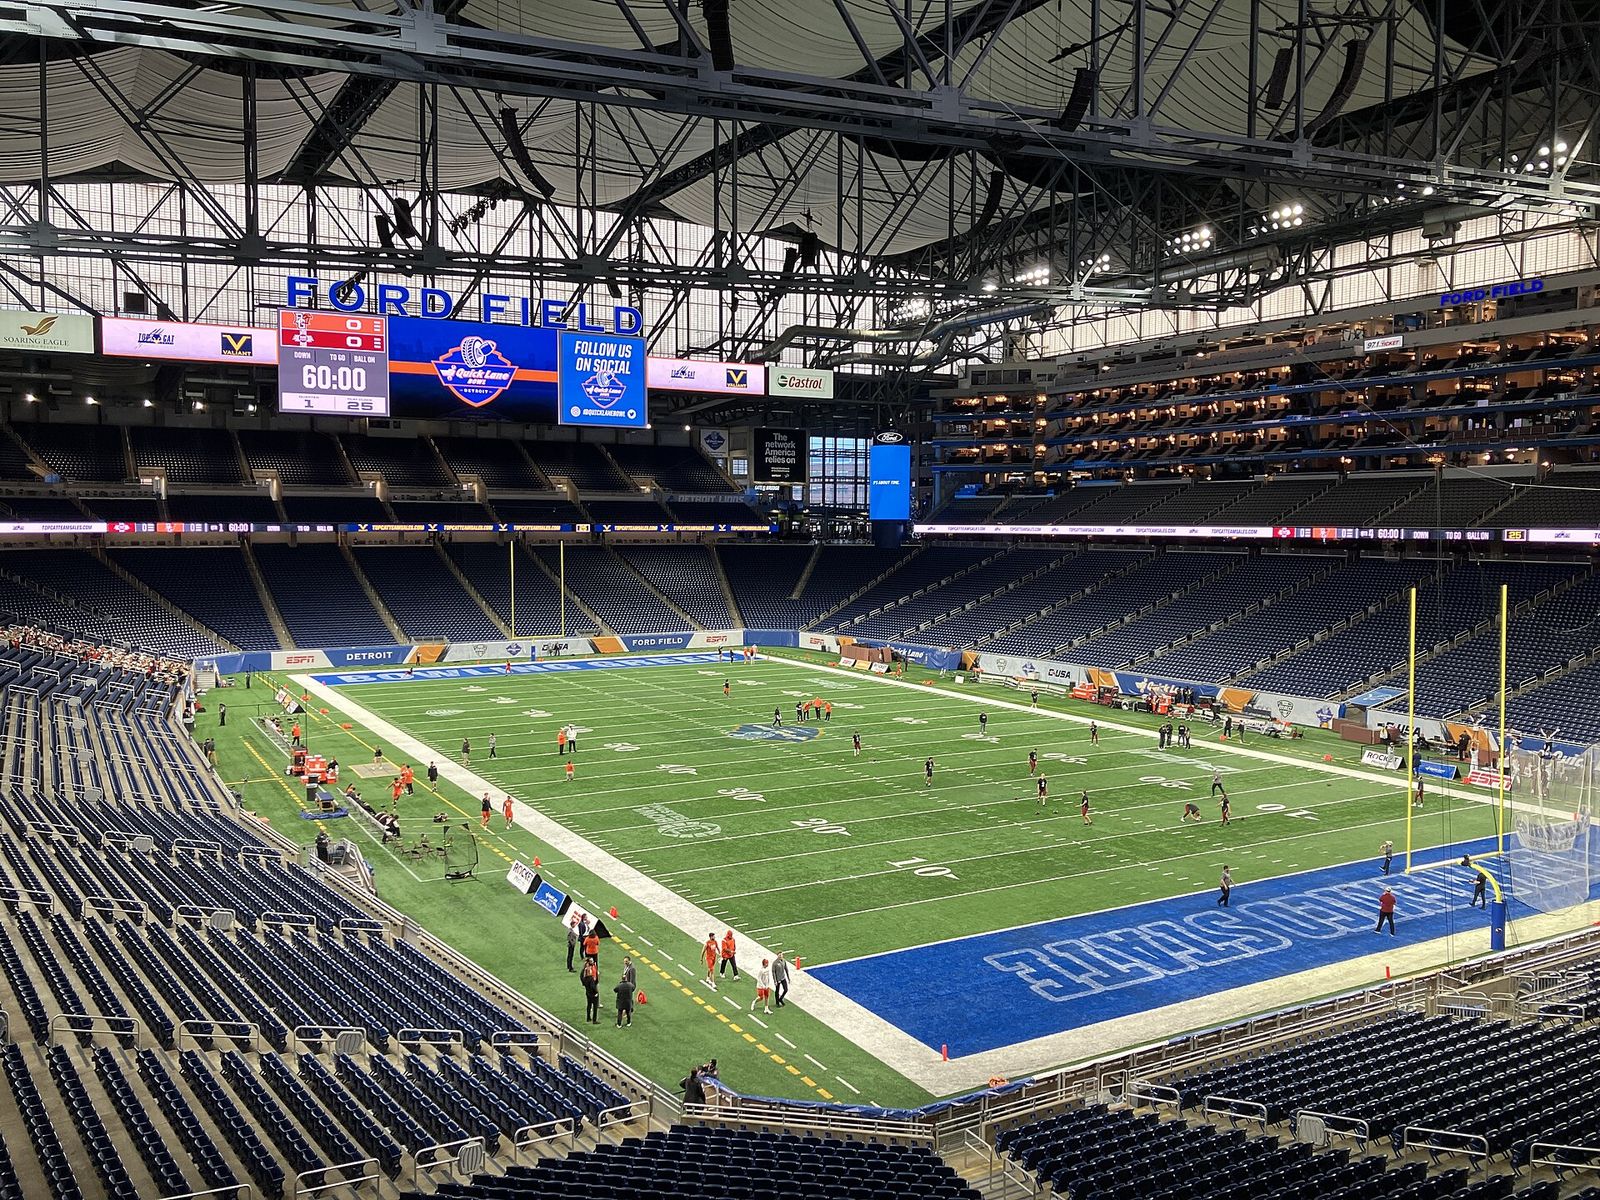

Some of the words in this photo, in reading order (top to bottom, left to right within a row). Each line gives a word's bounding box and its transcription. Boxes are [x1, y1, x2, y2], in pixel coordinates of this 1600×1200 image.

[1440, 288, 1486, 306] FORD
[1491, 279, 1544, 298] FIELD
[286, 275, 453, 319] FORD
[483, 293, 643, 335] FIELD
[3, 336, 41, 344] SOARING
[43, 338, 70, 346] EAGLE
[574, 341, 617, 357] FOLLOW
[618, 344, 633, 358] US
[294, 351, 311, 359] DOWN
[330, 353, 337, 361] TO
[354, 355, 367, 363] BALL
[575, 357, 592, 371] ON
[593, 358, 631, 374] SOCIAL
[302, 364, 367, 391] 60:00
[456, 368, 485, 379] Quick
[484, 370, 510, 380] Lane
[788, 376, 823, 389] Castrol
[304, 399, 314, 408] 1
[347, 401, 374, 411] 25
[772, 432, 788, 441] The
[881, 432, 898, 441] Ford
[765, 441, 796, 449] network
[764, 448, 796, 456] America
[765, 455, 785, 464] relies
[719, 495, 745, 503] LIONS
[228, 523, 249, 532] 60:00
[1377, 528, 1399, 539] 60:00
[1413, 531, 1429, 539] DOWN
[1467, 532, 1480, 540] BALL
[1480, 532, 1489, 540] ON
[1508, 531, 1522, 539] 25
[658, 637, 683, 645] FIELD
[706, 635, 728, 643] ESPN
[346, 651, 393, 661] DETROIT
[907, 649, 924, 658] Lane
[286, 655, 315, 664] ESPN
[337, 663, 581, 683] BOWLING
[587, 653, 737, 669] GREEN
[1471, 770, 1512, 788] ESPN
[886, 856, 952, 877] 10
